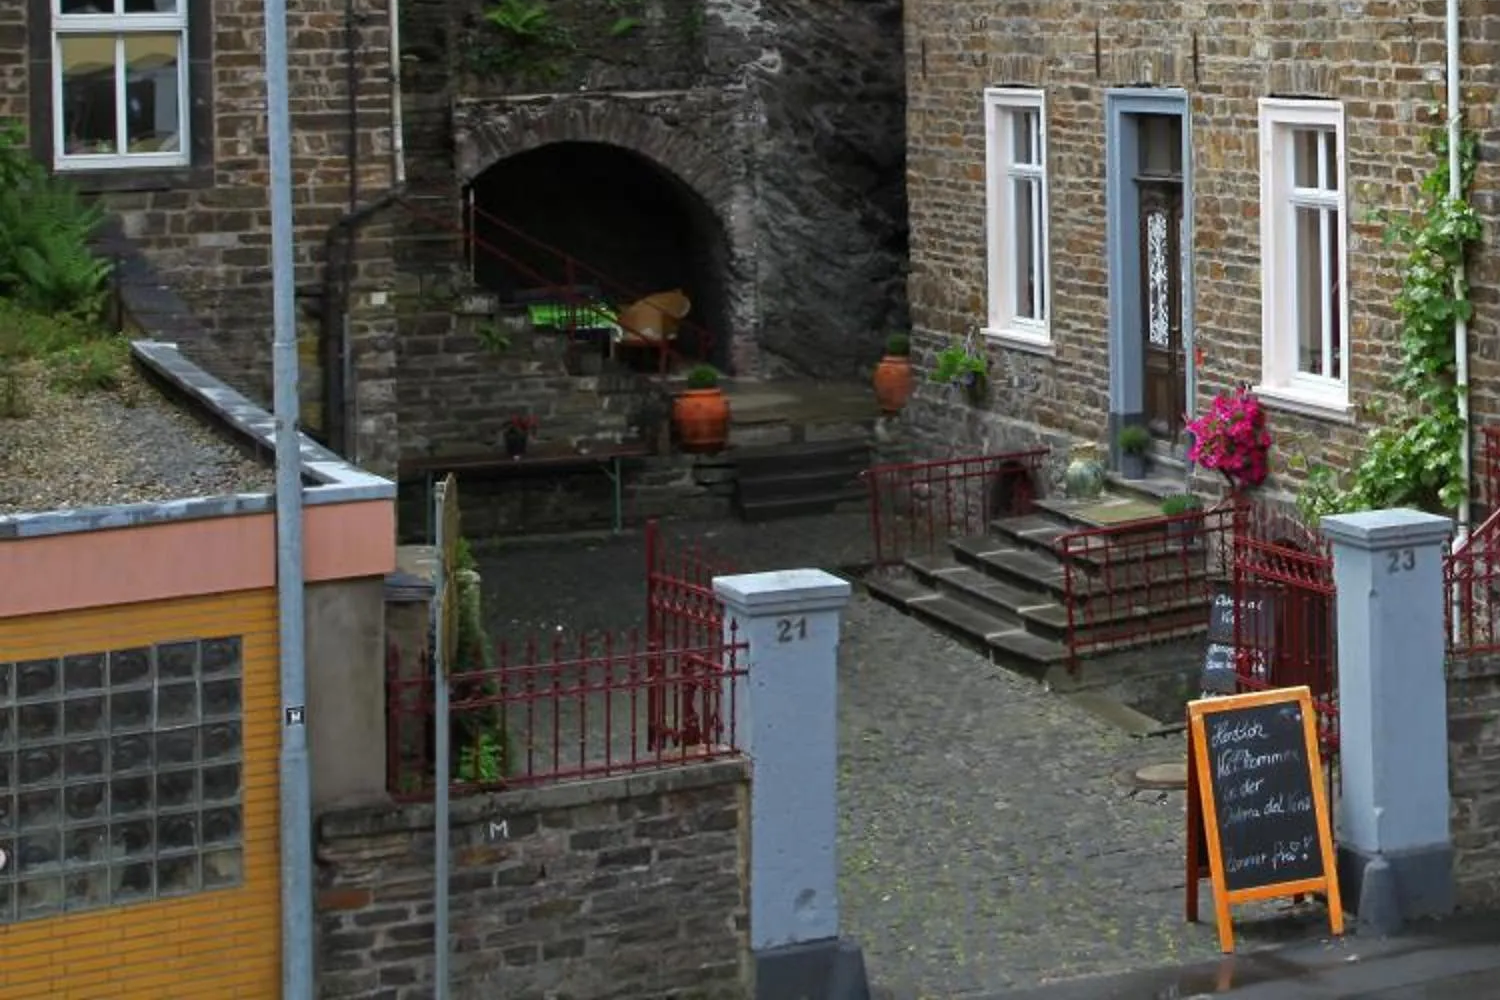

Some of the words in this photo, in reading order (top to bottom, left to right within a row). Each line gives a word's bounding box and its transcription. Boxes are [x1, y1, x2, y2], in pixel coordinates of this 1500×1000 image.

[1387, 549, 1416, 575] 23
[777, 617, 806, 643] 21
[489, 820, 508, 840] M
